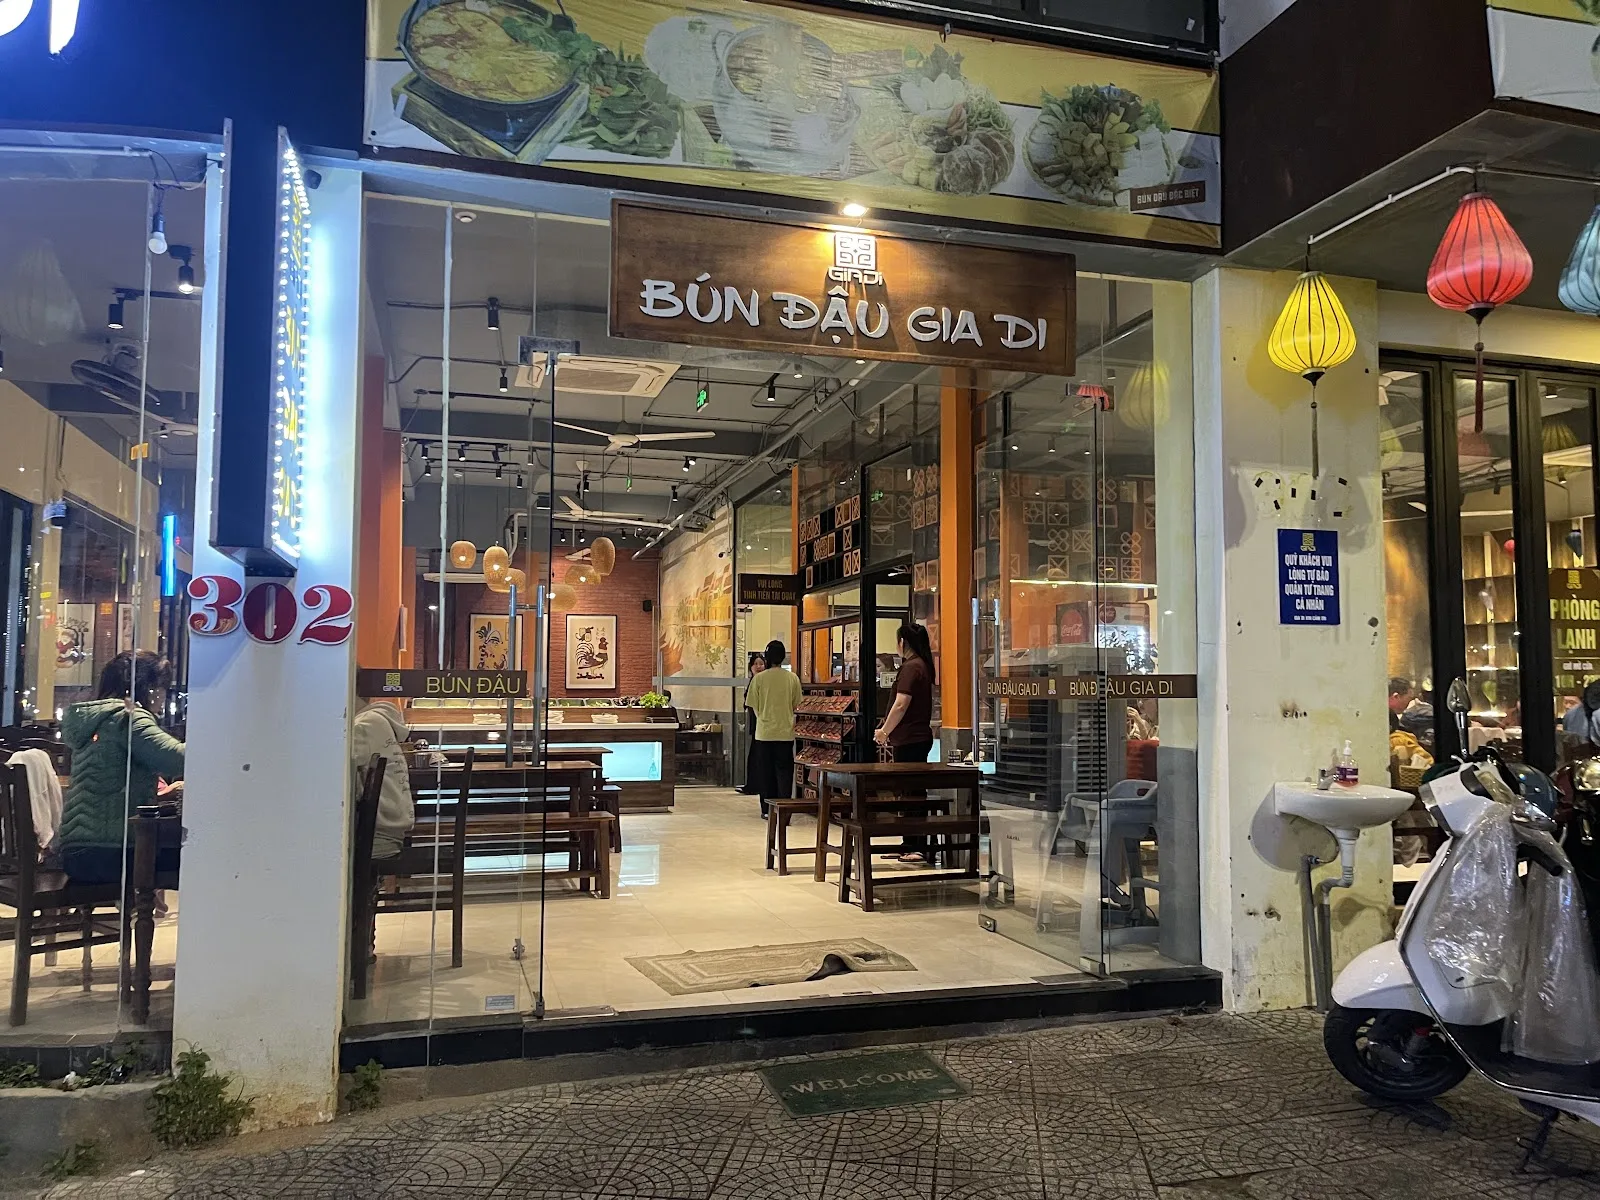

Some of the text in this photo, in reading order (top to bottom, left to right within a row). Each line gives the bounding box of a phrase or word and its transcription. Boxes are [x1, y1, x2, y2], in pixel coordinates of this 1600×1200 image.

[640, 273, 1047, 351] BÚN ĐẬU GIA DI
[1321, 555, 1333, 567] VUI
[1313, 584, 1334, 596] TRANG
[187, 575, 354, 645] 302
[1549, 593, 1600, 620] PHÒNG
[1557, 628, 1596, 654] LẠNH
[426, 673, 521, 697] BÚN ĐẬU
[1018, 683, 1031, 696] GIA
[1069, 678, 1089, 696] BÚN
[1129, 680, 1155, 695] GIA
[1158, 680, 1173, 695] DI
[791, 1068, 938, 1094] WELCOME
